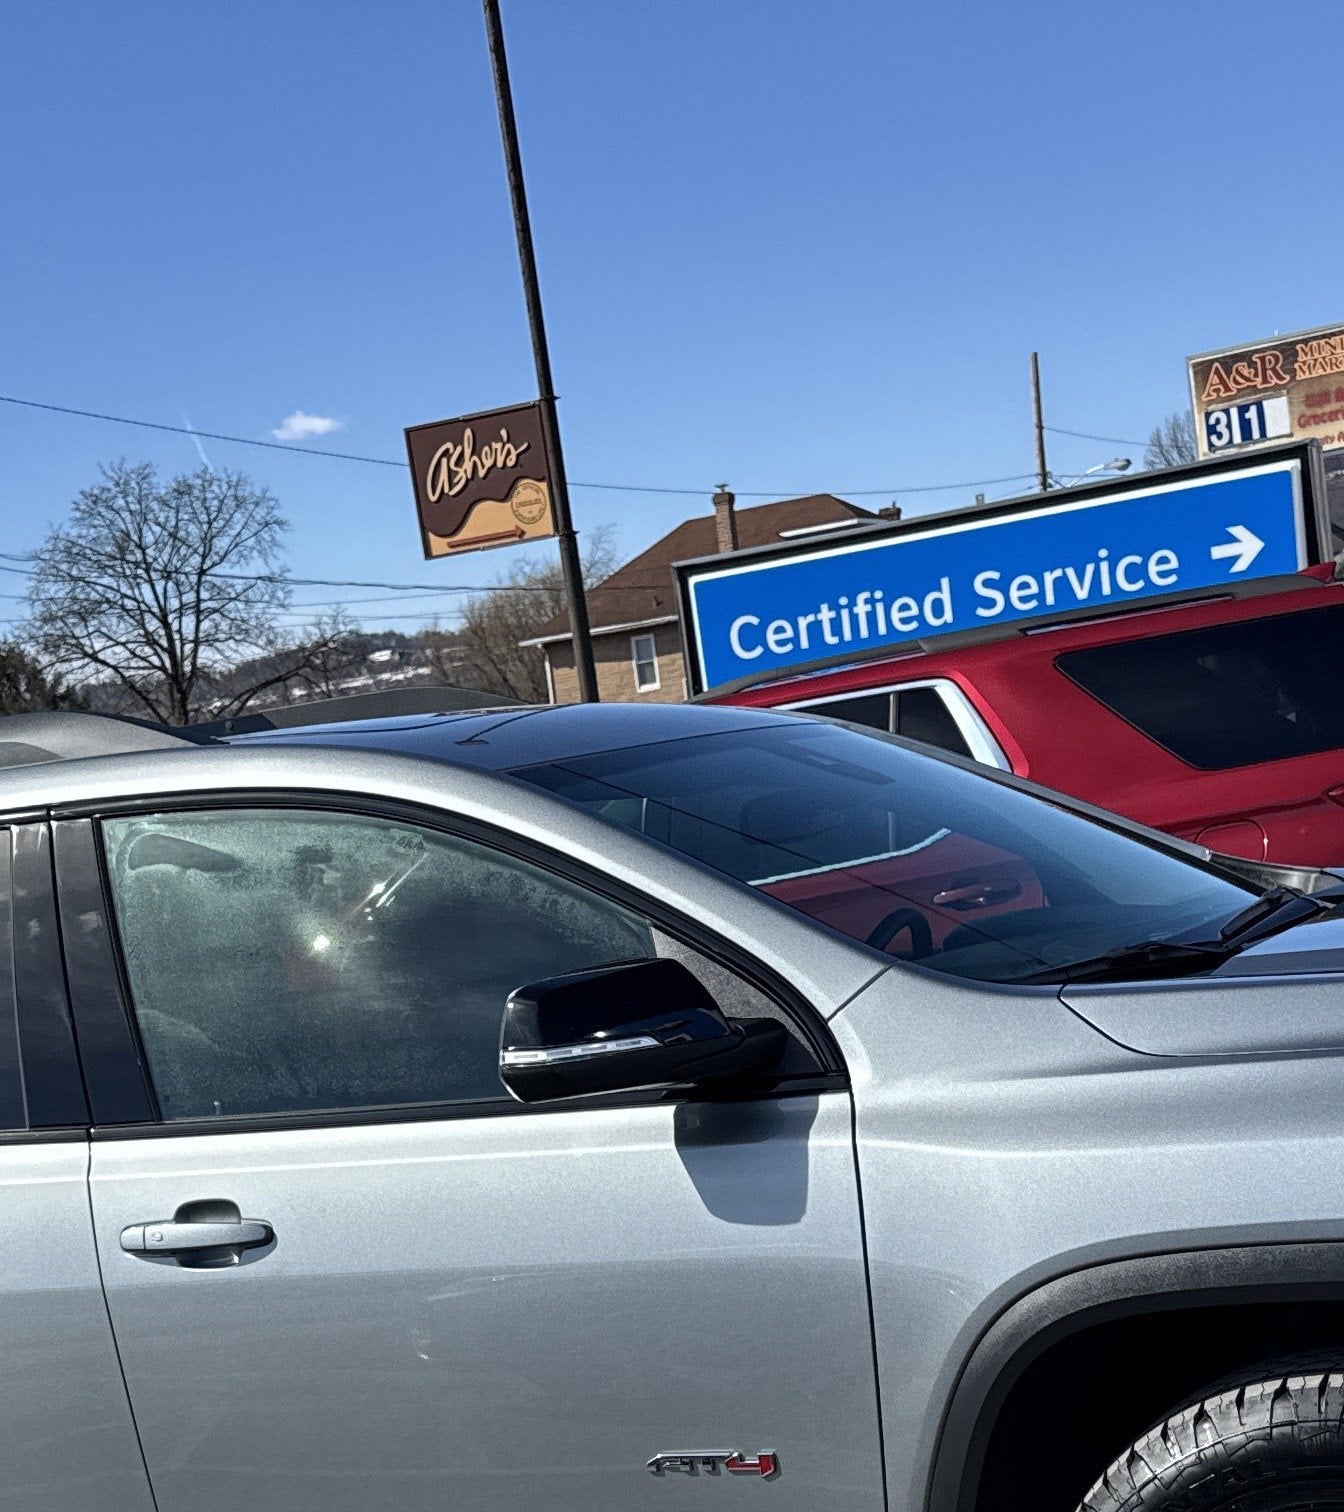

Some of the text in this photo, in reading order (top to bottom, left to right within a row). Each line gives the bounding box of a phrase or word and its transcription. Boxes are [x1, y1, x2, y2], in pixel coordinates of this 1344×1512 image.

[1202, 350, 1290, 401] A&R
[729, 547, 1180, 662] Certified Service
[646, 1451, 776, 1477] AT4
